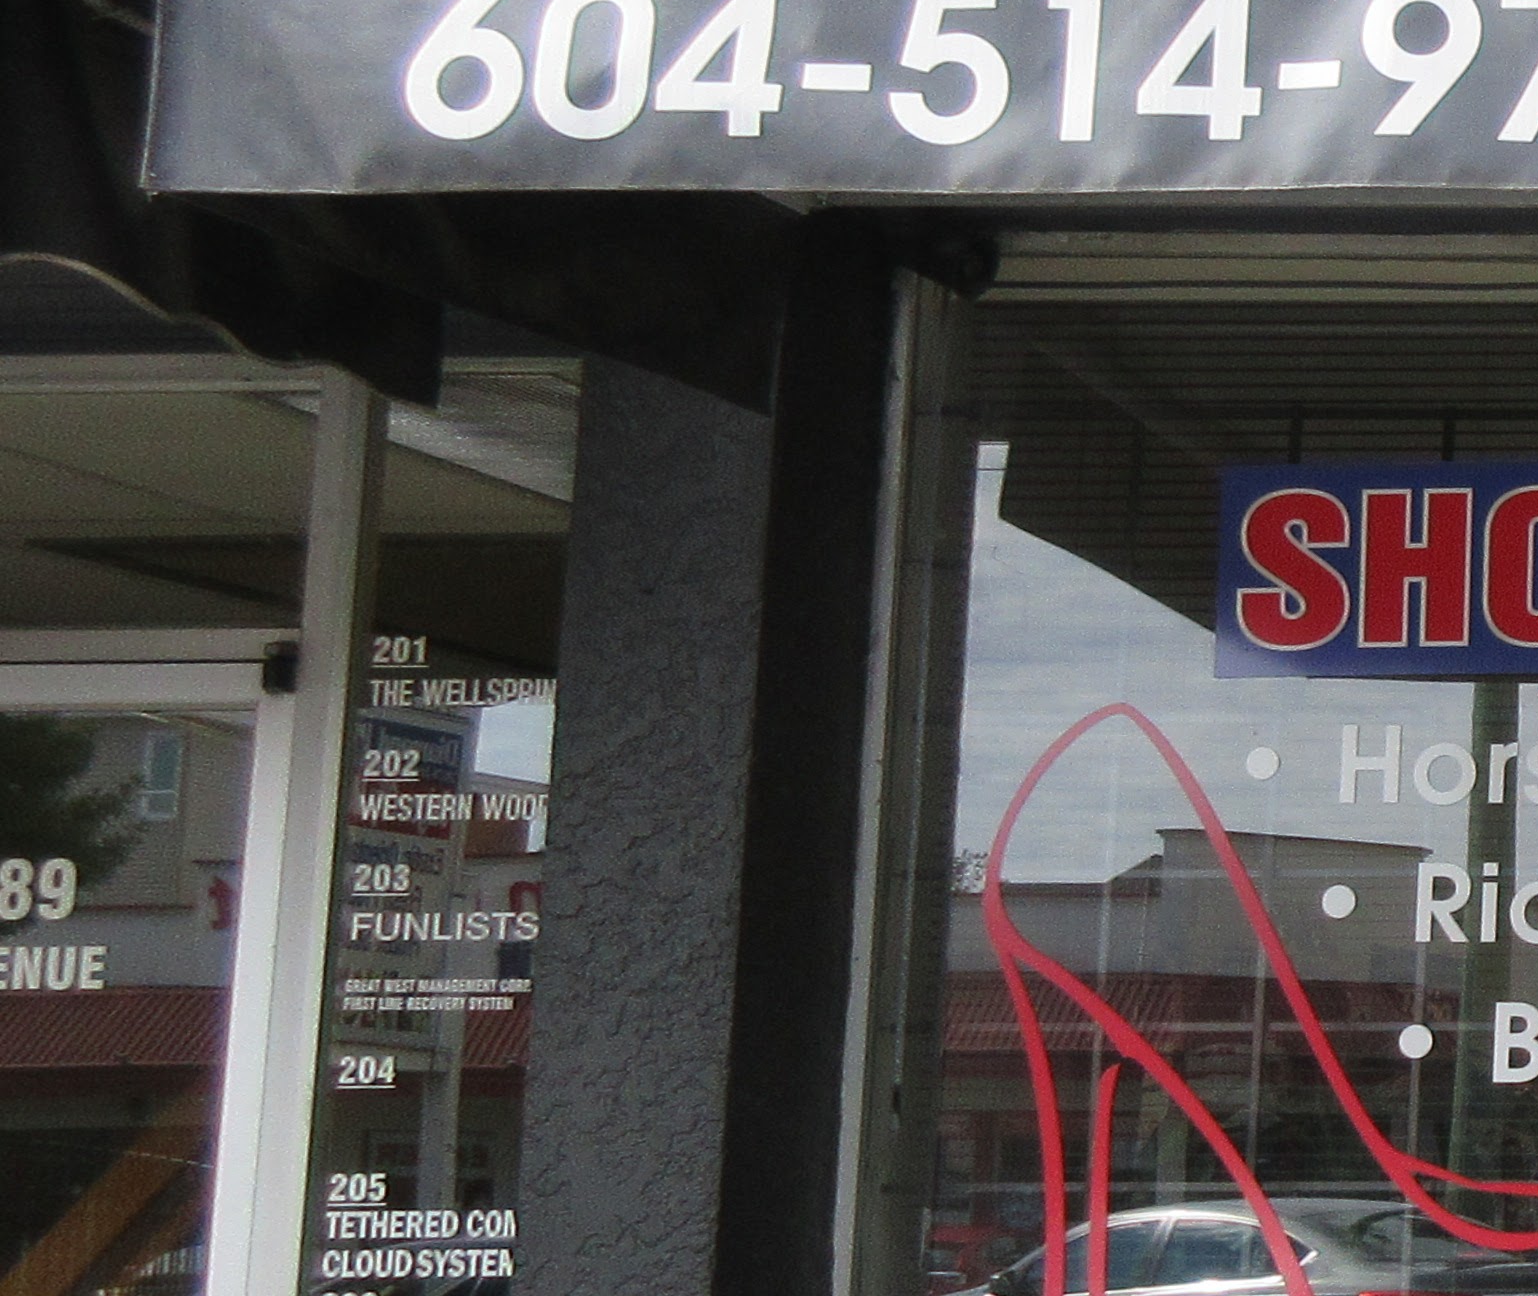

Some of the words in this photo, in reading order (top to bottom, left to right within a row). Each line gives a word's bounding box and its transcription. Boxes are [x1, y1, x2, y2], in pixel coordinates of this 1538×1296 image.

[372, 636, 429, 667] 201
[370, 679, 414, 706] THE
[362, 750, 421, 781] 202
[360, 794, 473, 821] WESTERN
[351, 864, 410, 896] 203
[350, 911, 540, 941] FUNLISTS
[336, 1056, 397, 1089] 204
[327, 1173, 387, 1207] 205
[326, 1210, 459, 1239] TETHERED
[321, 1249, 413, 1278] CLOUD
